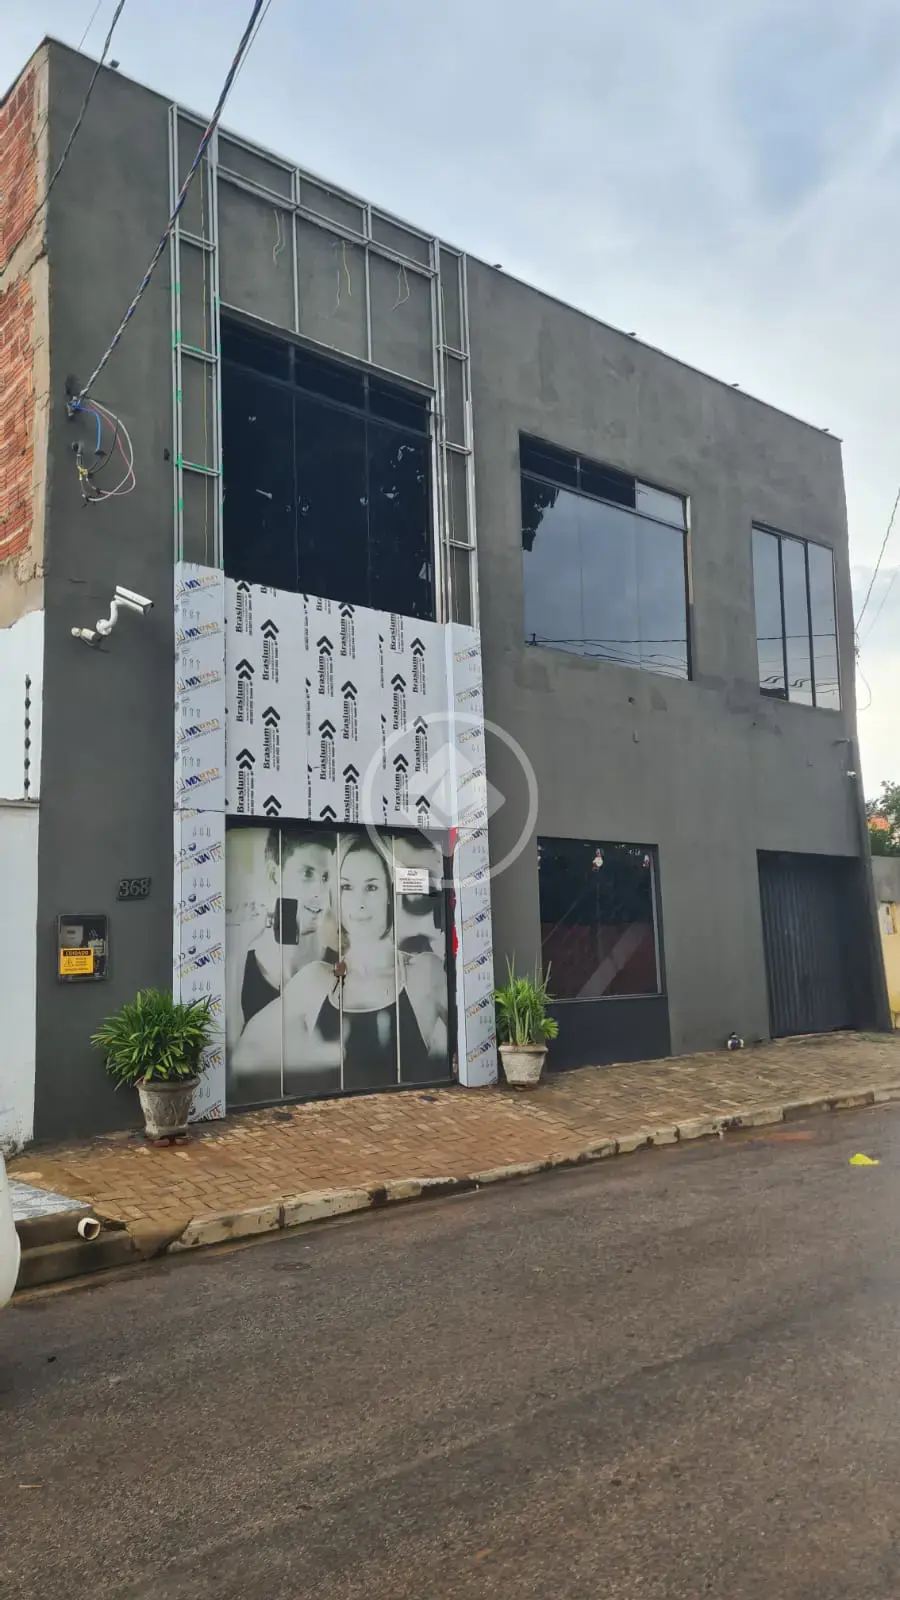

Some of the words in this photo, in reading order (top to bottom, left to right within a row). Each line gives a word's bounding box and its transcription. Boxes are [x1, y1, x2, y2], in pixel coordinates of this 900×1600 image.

[235, 592, 243, 633] Braslum
[340, 618, 348, 657] Braslum
[261, 640, 269, 680] Braslum
[317, 656, 325, 695] Braslum
[236, 680, 244, 722] Braslum
[342, 700, 350, 740] Braslum
[392, 692, 400, 730] Braslum
[263, 728, 271, 769] Braslum
[320, 740, 328, 780] Braslum
[237, 770, 245, 813] Braslum
[394, 773, 402, 811] Braslum
[119, 879, 150, 897] 368
